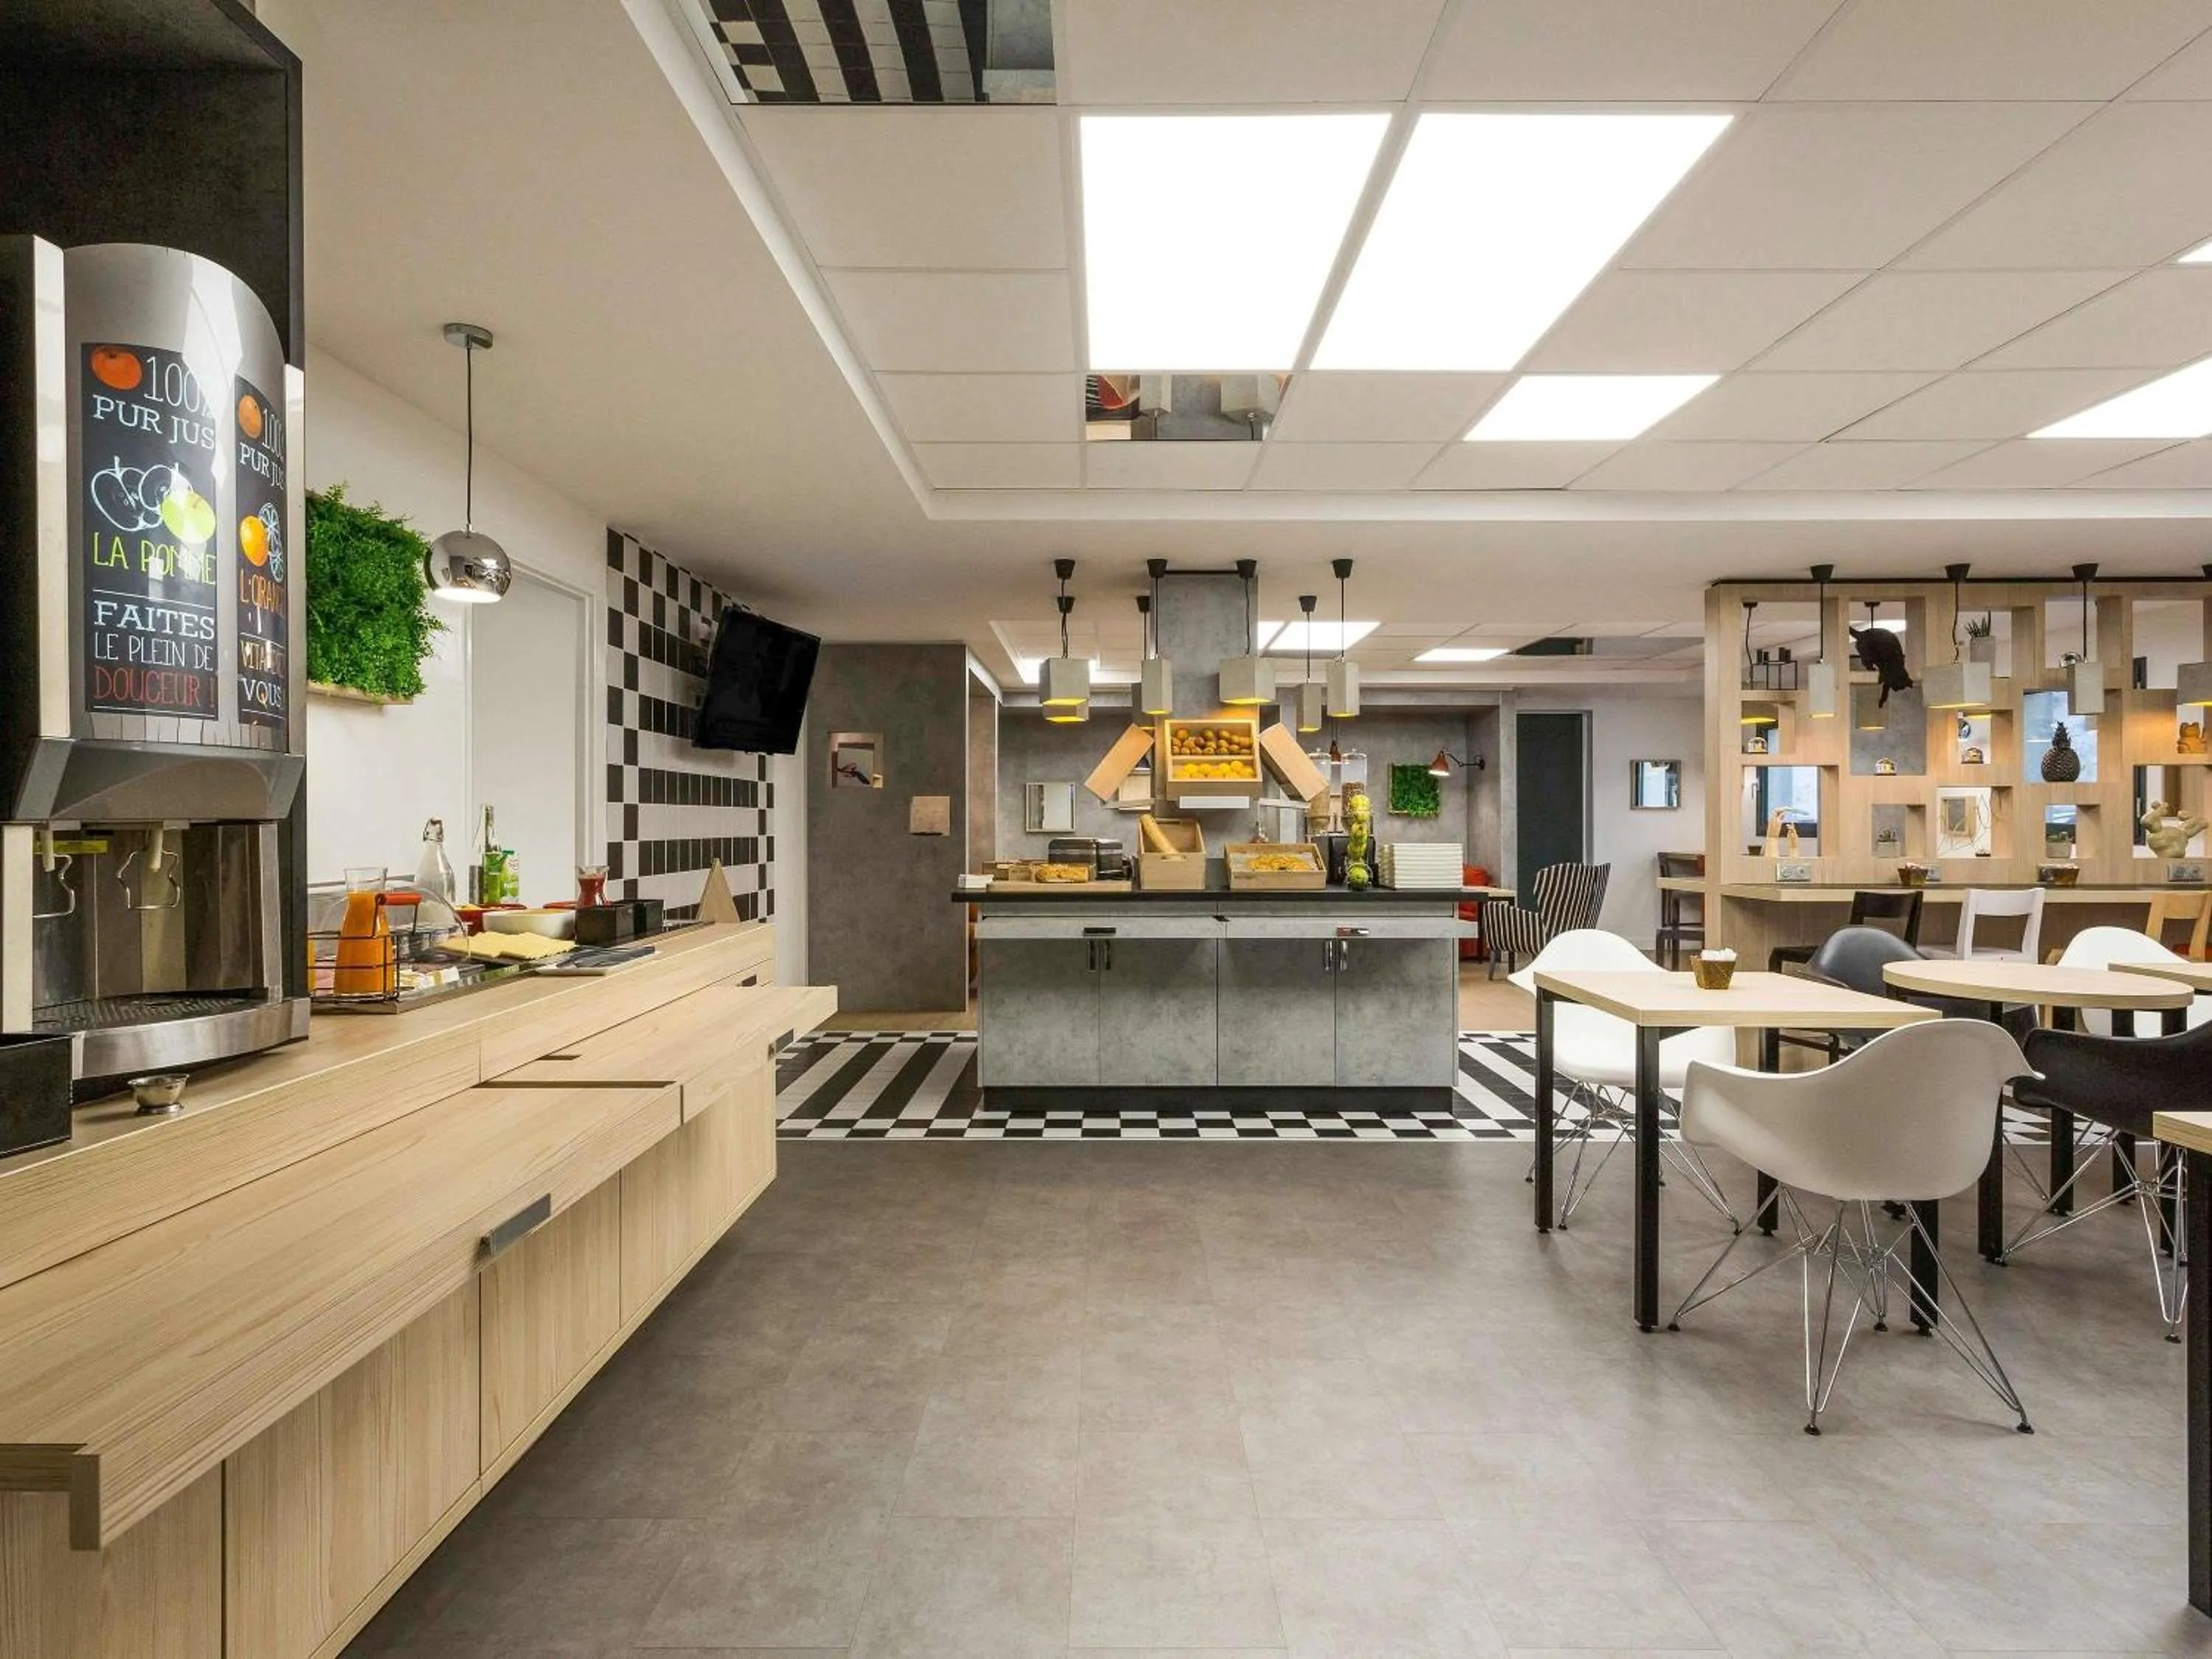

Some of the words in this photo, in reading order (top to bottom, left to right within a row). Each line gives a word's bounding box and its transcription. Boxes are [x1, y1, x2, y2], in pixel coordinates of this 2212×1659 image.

[92, 394, 162, 434] PUR
[169, 416, 215, 450] JUS
[240, 442, 270, 478] PUR
[94, 532, 129, 570] LA
[94, 600, 215, 640] FAITES
[95, 632, 119, 660] LE
[129, 635, 185, 667] PLEIN
[193, 644, 213, 671] DE
[94, 665, 201, 707] DOUCEUR
